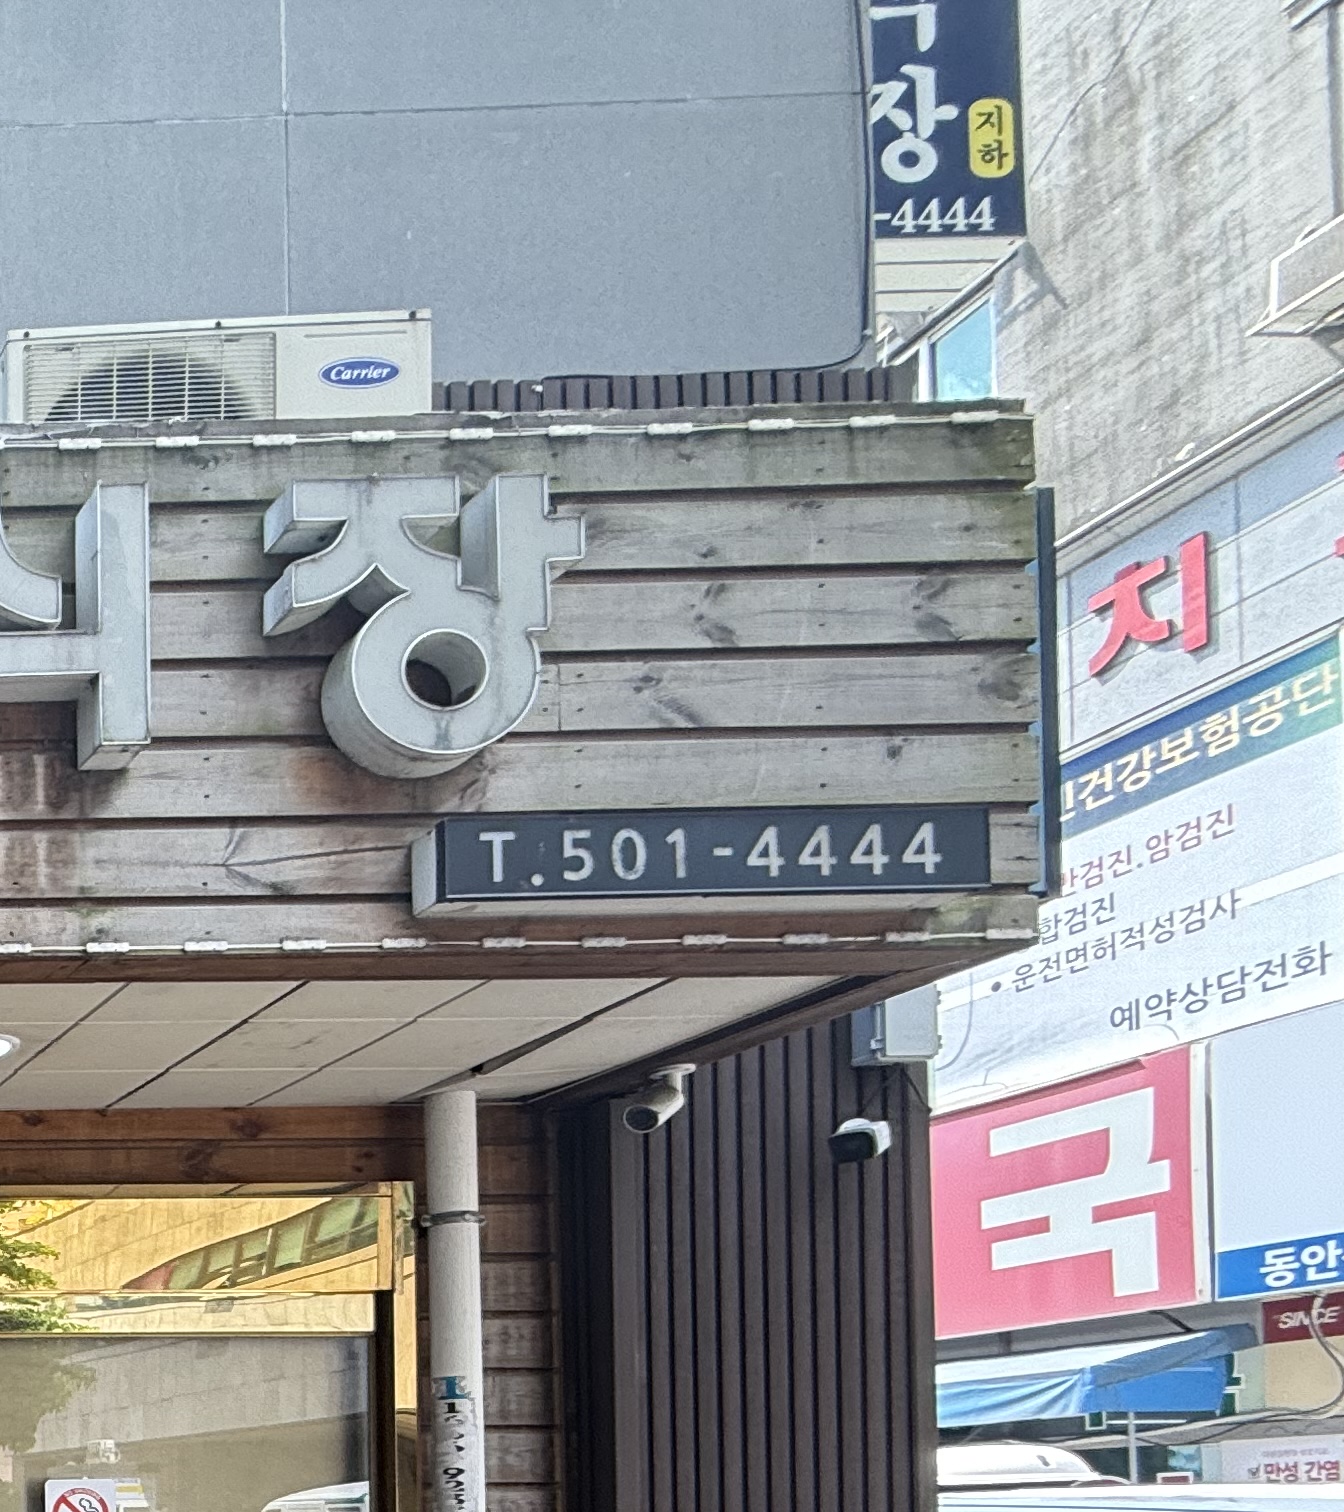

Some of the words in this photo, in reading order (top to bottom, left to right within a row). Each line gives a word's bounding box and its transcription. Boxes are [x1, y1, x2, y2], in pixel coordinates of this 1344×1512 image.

[975, 104, 1009, 170] 지하
[329, 363, 392, 381] Carrier
[479, 821, 943, 888] T.501-4444
[1011, 888, 1242, 993] 운전면허적성검사
[1110, 940, 1333, 1032] 예약상담전화
[981, 1086, 1171, 1297] 국
[1259, 1239, 1344, 1288] 동안
[1277, 1306, 1342, 1329] SINCE
[1263, 1462, 1299, 1483] 만성
[1304, 1459, 1342, 1482] 간염
